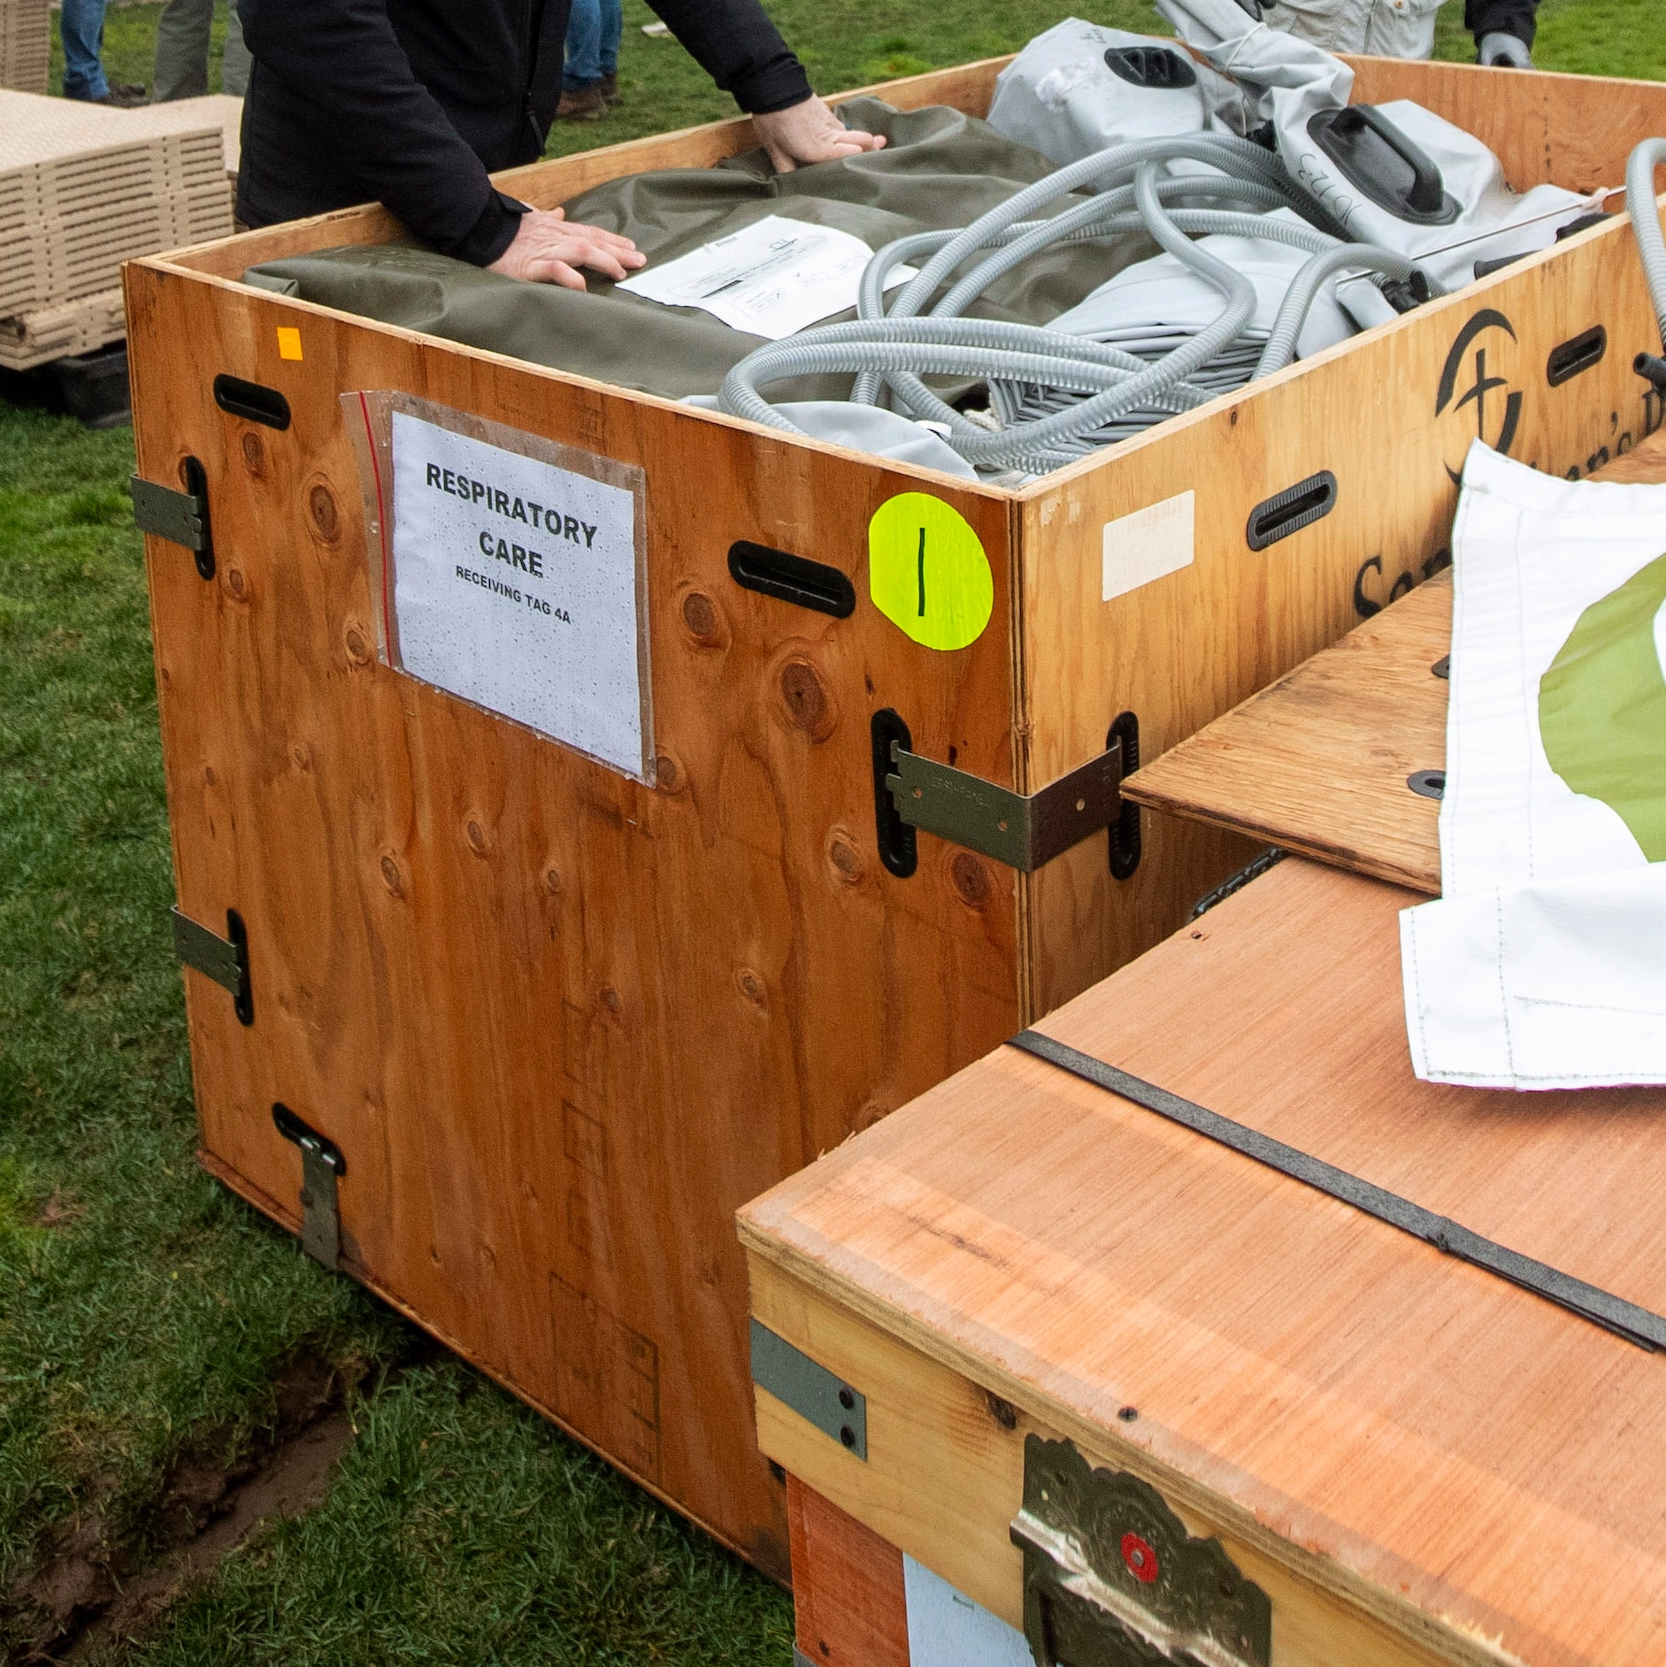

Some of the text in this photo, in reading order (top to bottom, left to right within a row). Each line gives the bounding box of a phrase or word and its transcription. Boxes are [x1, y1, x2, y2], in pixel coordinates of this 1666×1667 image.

[427, 462, 598, 549] RESPIRATORY
[479, 531, 543, 578] CARE
[455, 565, 572, 625] RECEIVING TAG 4A
